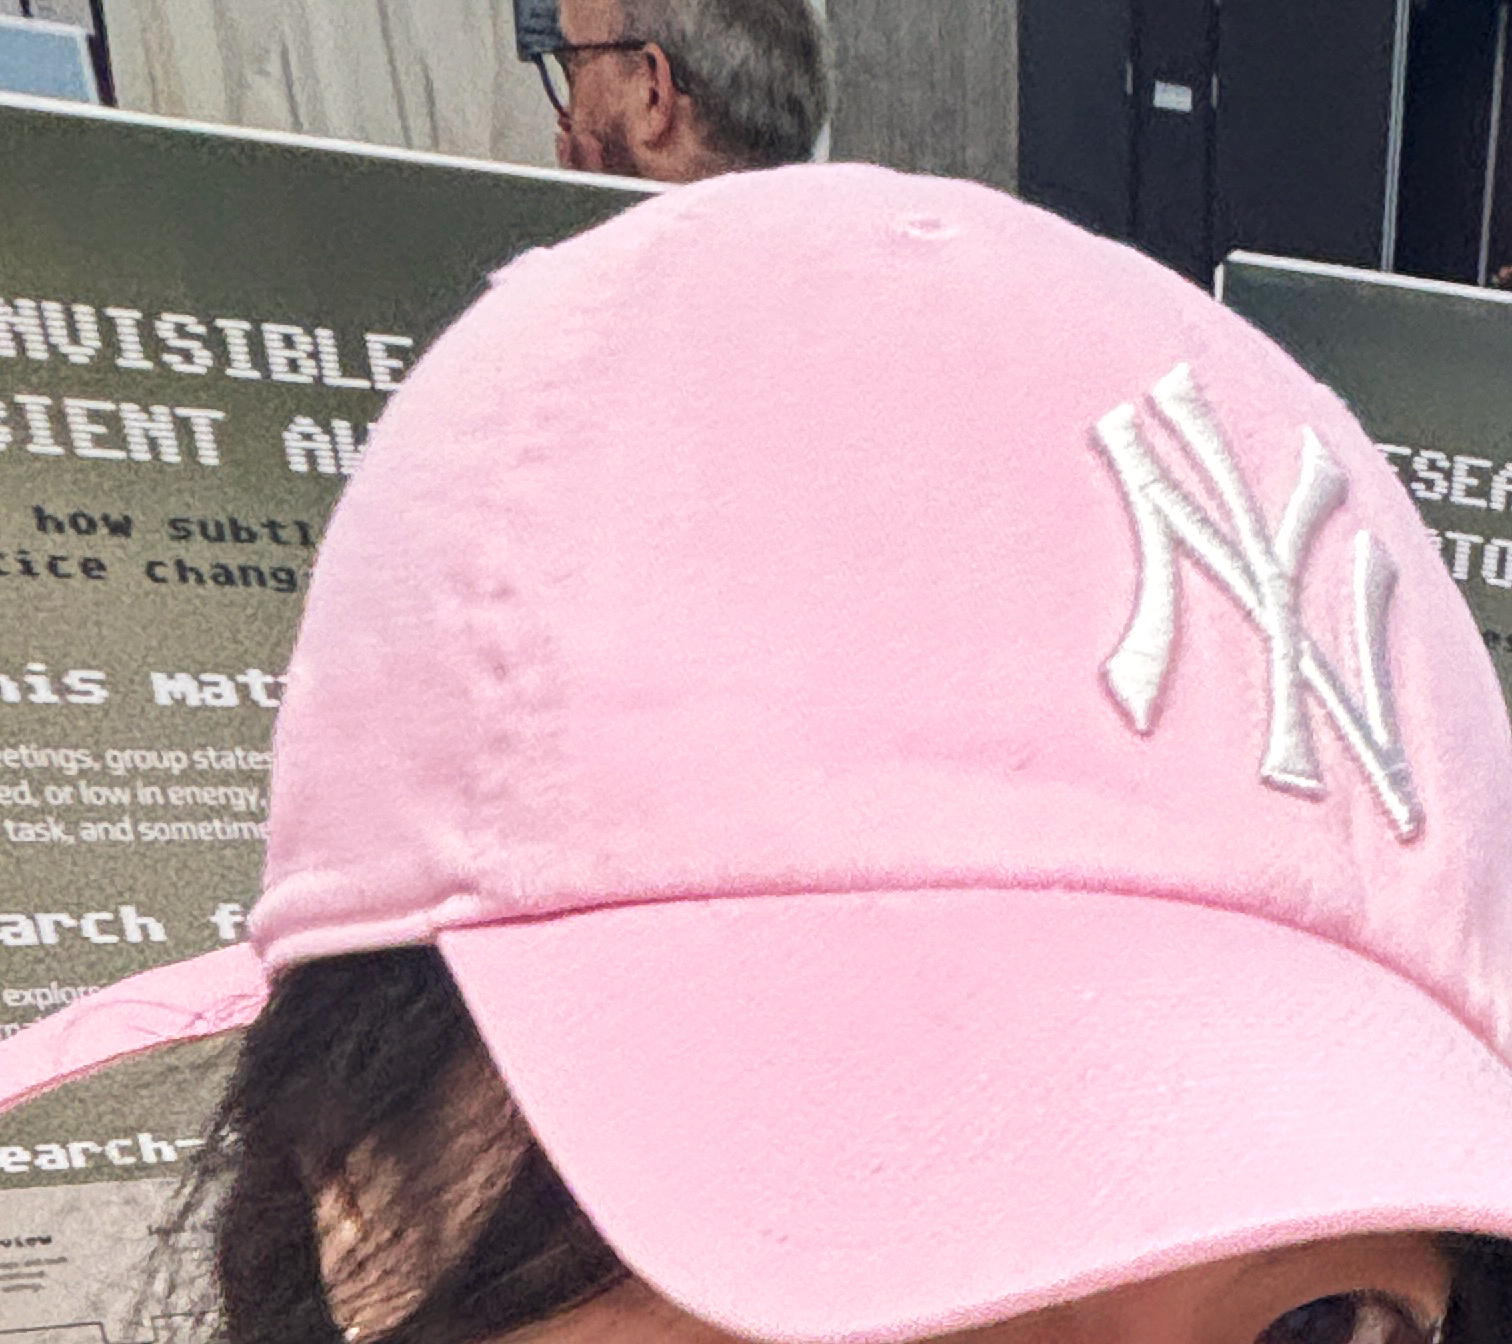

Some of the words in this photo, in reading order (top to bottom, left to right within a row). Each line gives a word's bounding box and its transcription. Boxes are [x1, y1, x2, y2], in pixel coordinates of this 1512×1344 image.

[0, 393, 226, 466] IENT
[31, 505, 133, 539] how
[147, 558, 310, 594] chang
